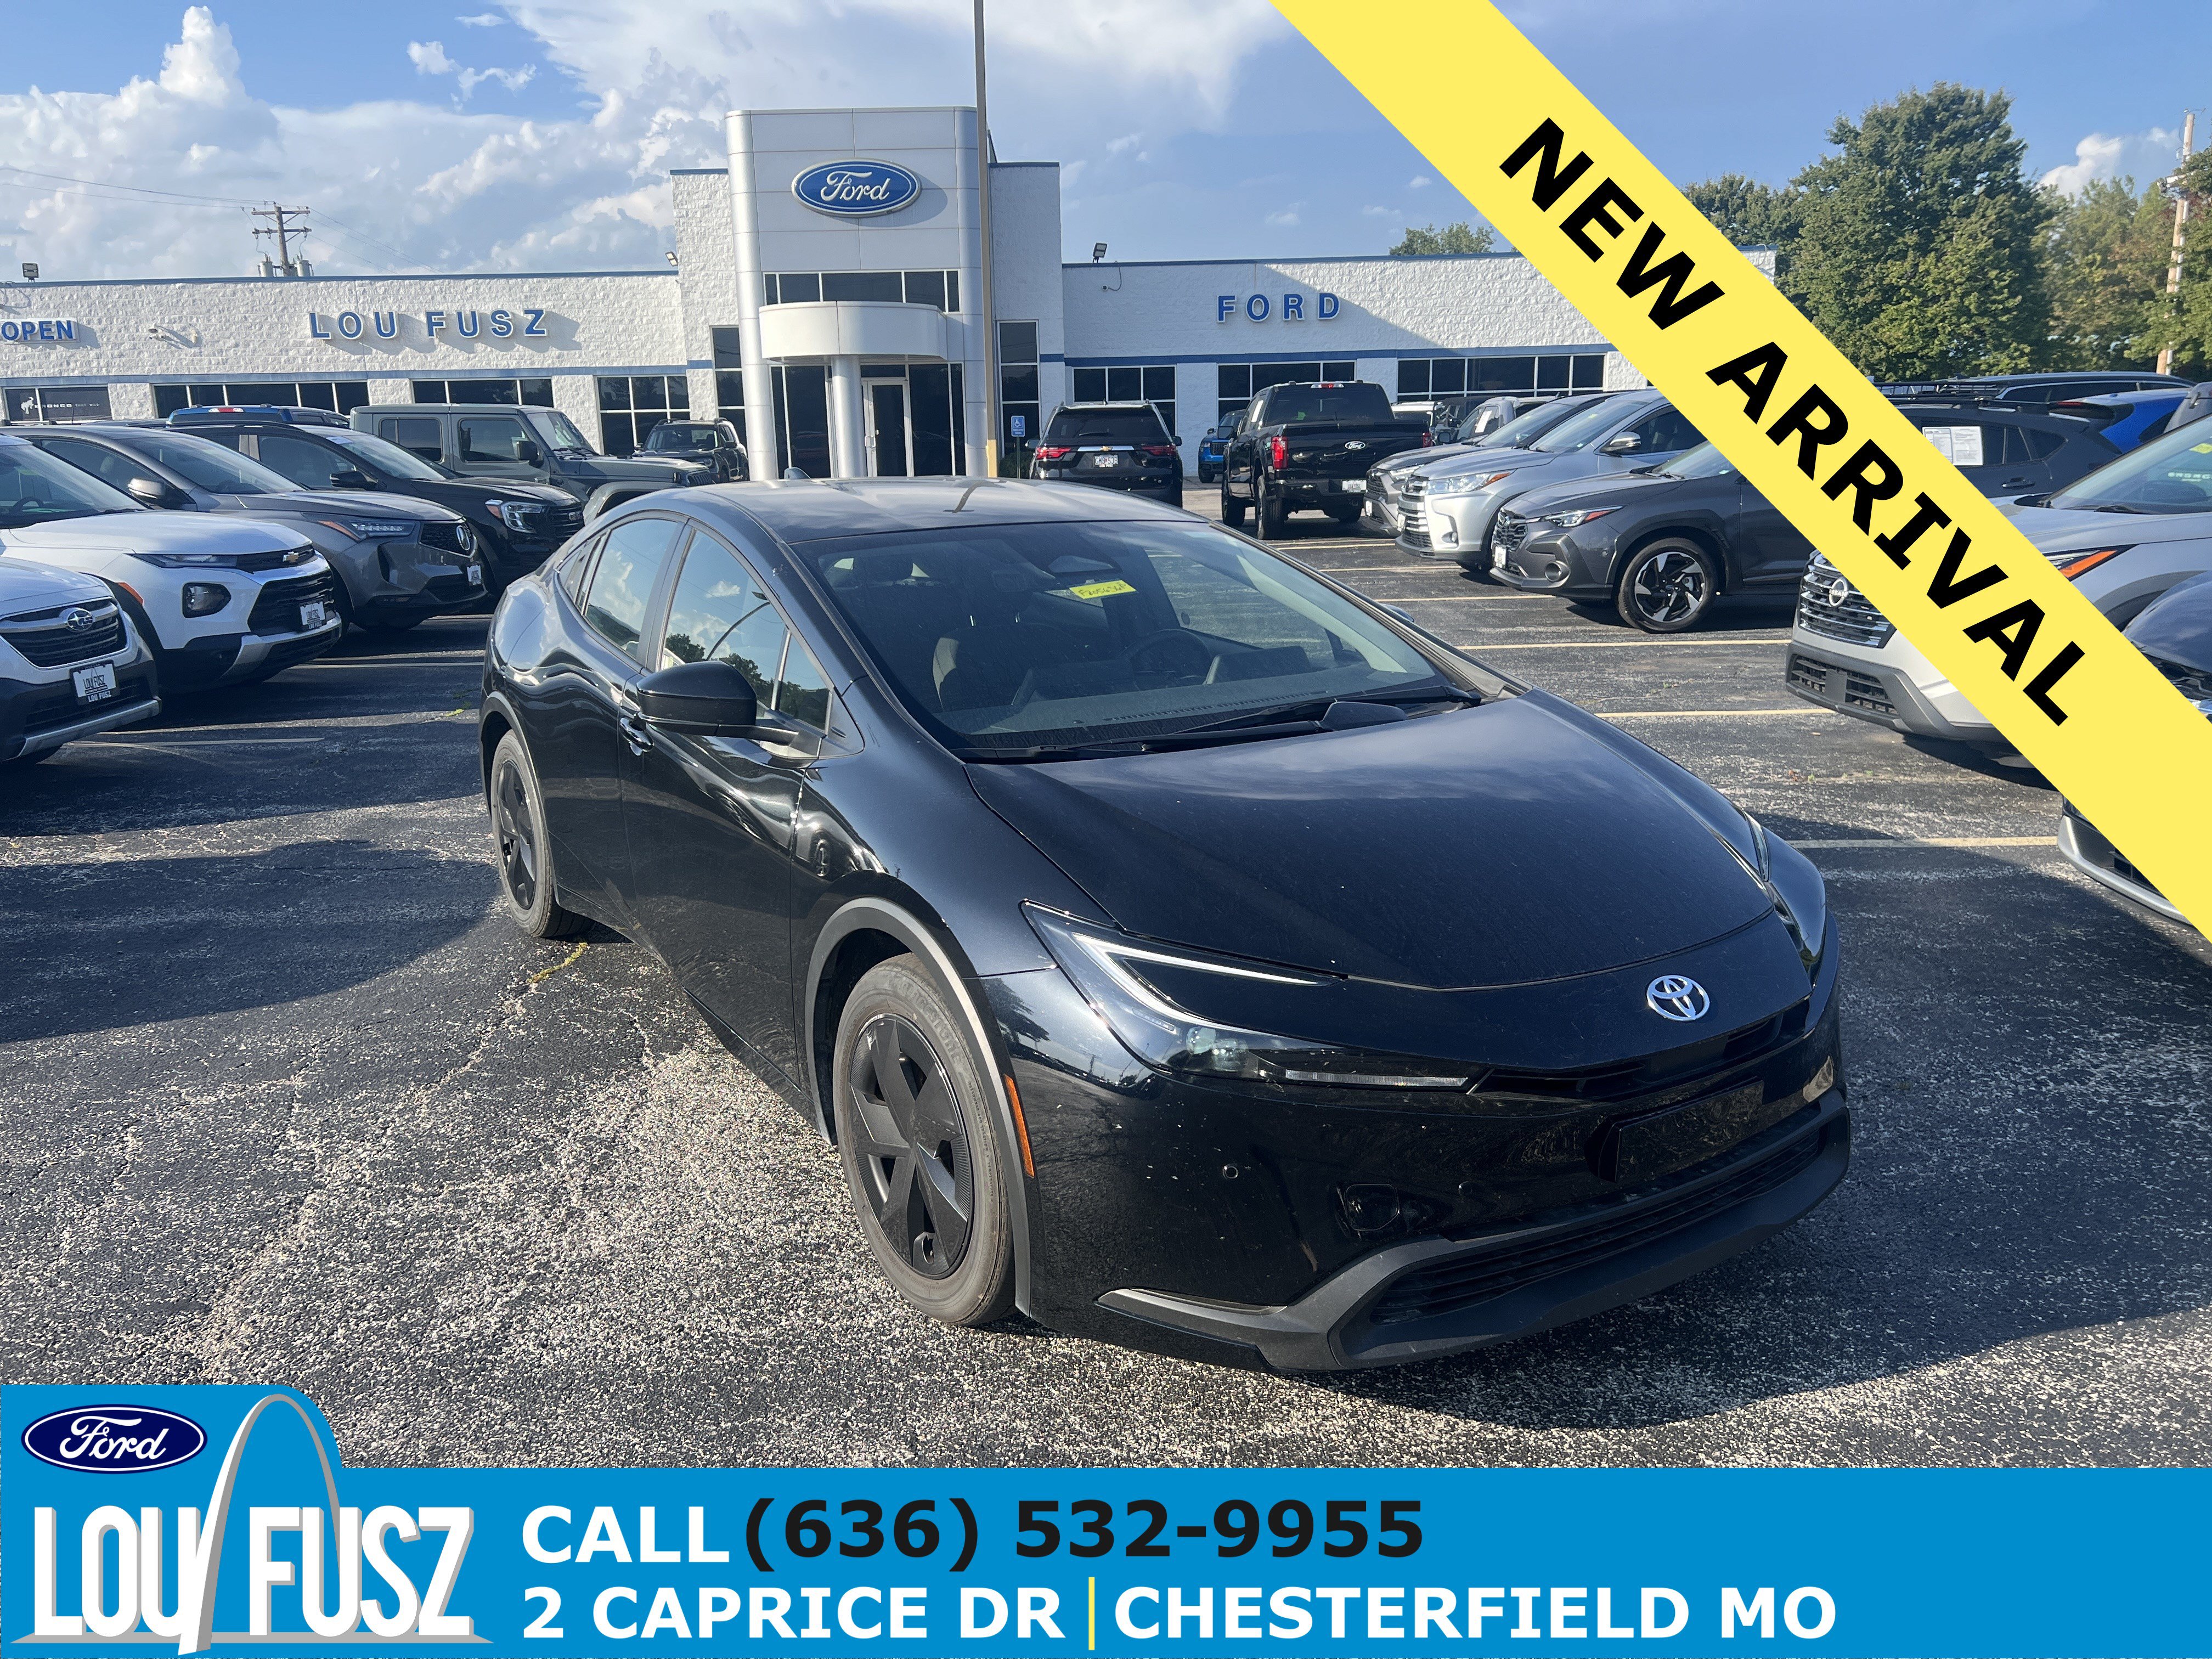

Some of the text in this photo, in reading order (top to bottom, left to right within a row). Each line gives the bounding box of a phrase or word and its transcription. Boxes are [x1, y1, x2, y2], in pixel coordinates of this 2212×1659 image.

[820, 171, 890, 201] Ford
[1217, 292, 1340, 323] FORD
[1, 320, 74, 341] OPEN
[309, 309, 547, 340] LOU FUSZ
[83, 678, 94, 689] LOU
[88, 690, 112, 702] LOU FUSZ
